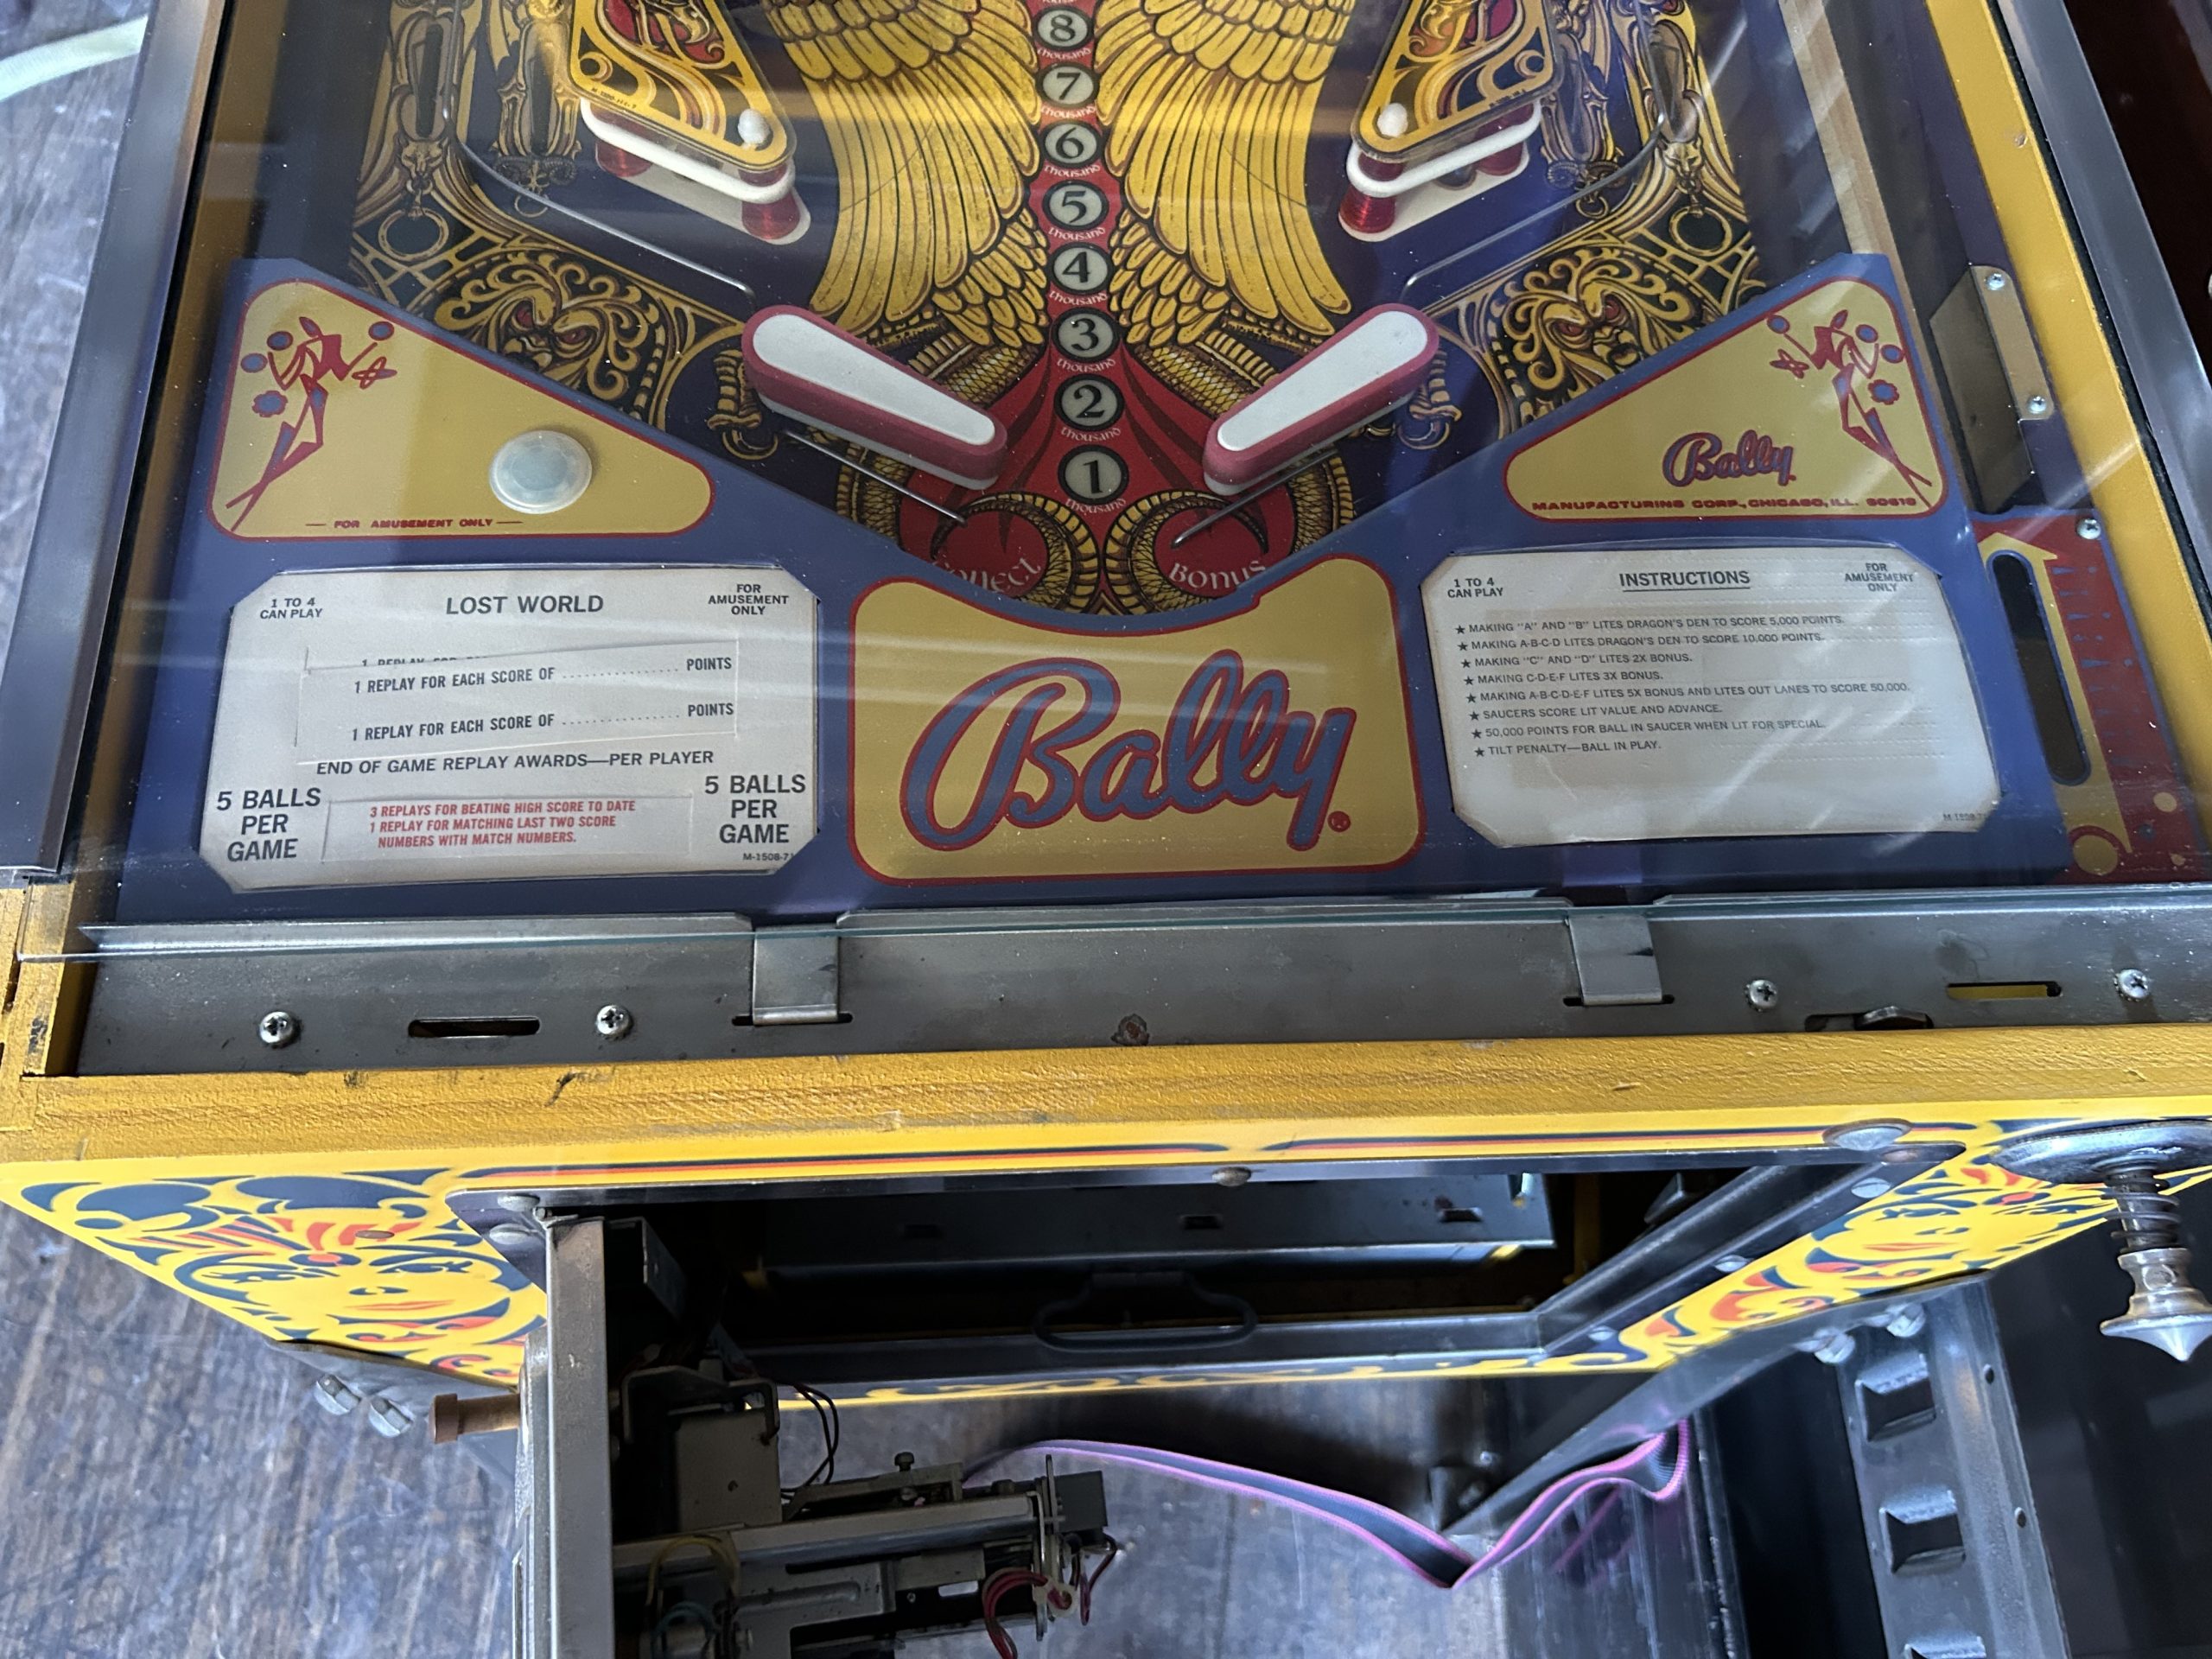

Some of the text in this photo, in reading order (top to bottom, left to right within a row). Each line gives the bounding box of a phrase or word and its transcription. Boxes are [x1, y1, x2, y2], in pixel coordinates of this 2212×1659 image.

[1050, 14, 1076, 41] 8
[1056, 72, 1081, 100] 7
[1055, 127, 1084, 159] 6
[1062, 190, 1087, 224] 5
[1062, 251, 1090, 283] 4
[1071, 318, 1099, 351] 3
[1073, 385, 1105, 418] 2
[1662, 429, 1795, 487] Bally
[1083, 460, 1103, 494] 1
[1532, 499, 1685, 510] MANUFACTURING
[334, 518, 493, 529] FOR AMUSEMENT ONLY
[1866, 563, 1887, 572] FOR
[1454, 577, 1495, 588] 1 TO 4
[1619, 570, 1751, 587] INSTRUCTIONS
[1844, 573, 1914, 582] AMUSEMENT
[736, 584, 761, 594] FOR
[1447, 588, 1503, 598] CAN PLAY
[1868, 582, 1897, 592] ONLY
[271, 597, 315, 608] 1 TO 4
[446, 594, 603, 615] LOST WORLD
[708, 595, 788, 605] AMUSEMENT
[259, 608, 323, 620] CAN PLAY
[731, 606, 766, 615] ONLY
[1469, 623, 1514, 632] MAKING
[1541, 621, 1566, 631] AND
[1593, 620, 1624, 629] LITES
[1626, 619, 1683, 629] DRAGON'S
[1687, 619, 1710, 627] DEN
[1714, 619, 1727, 627] TO
[1730, 617, 1766, 626] SCORE
[1770, 617, 1799, 626] 5,000
[1802, 615, 1844, 625] POINTS.
[1471, 632, 1825, 650] MAKING A-B-C-D LITES DRAGON'S DEN TO SCORE 10,000 POINTS.
[1475, 657, 1520, 667] MAKING
[1548, 655, 1571, 664] AND
[1599, 654, 1630, 664] LITES
[1633, 653, 1647, 663] 2X
[1650, 653, 1692, 663] BONUS.
[354, 657, 733, 694] 1 REPLAY FOR EACH SCORE OF POINTS
[1478, 671, 1663, 684] MAKING C-D-E-F LITES 3X BONUS.
[1480, 683, 1868, 702] MAKING A-B-C-D-E-F LITES 5X BONUS AND LITES OUT LANES TO SCORE
[1484, 703, 1723, 719] SAUCERS SCORE LIT VALUE AND ADVANCE.
[353, 703, 734, 741] 1 REPLAY FOR EACH SCORE OF POINTS
[1485, 719, 1826, 738] 50,000 POINTS FOR BALL IN SAUCER WHEN LIT FOR SPECIAL.
[899, 649, 1357, 852] Bally
[1488, 740, 1662, 755] TILT IN PLAY.
[316, 750, 714, 774] END OF GAME REPLAY PLAYER
[704, 774, 806, 795] 5 BALLS
[216, 787, 321, 810] 5 BALLS
[370, 800, 636, 817] 3 REPLAYS FOR BEATING HIGH SCORE TO DATE
[731, 799, 778, 819] PER
[240, 814, 289, 835] PER
[370, 816, 616, 833] 1 REPLAY FOR MATCHING LAST TWO SCORE
[719, 823, 790, 844] GAME
[378, 831, 577, 849] NUMBERS WITH MATCH NUMBERS.
[227, 838, 298, 862] GAME
